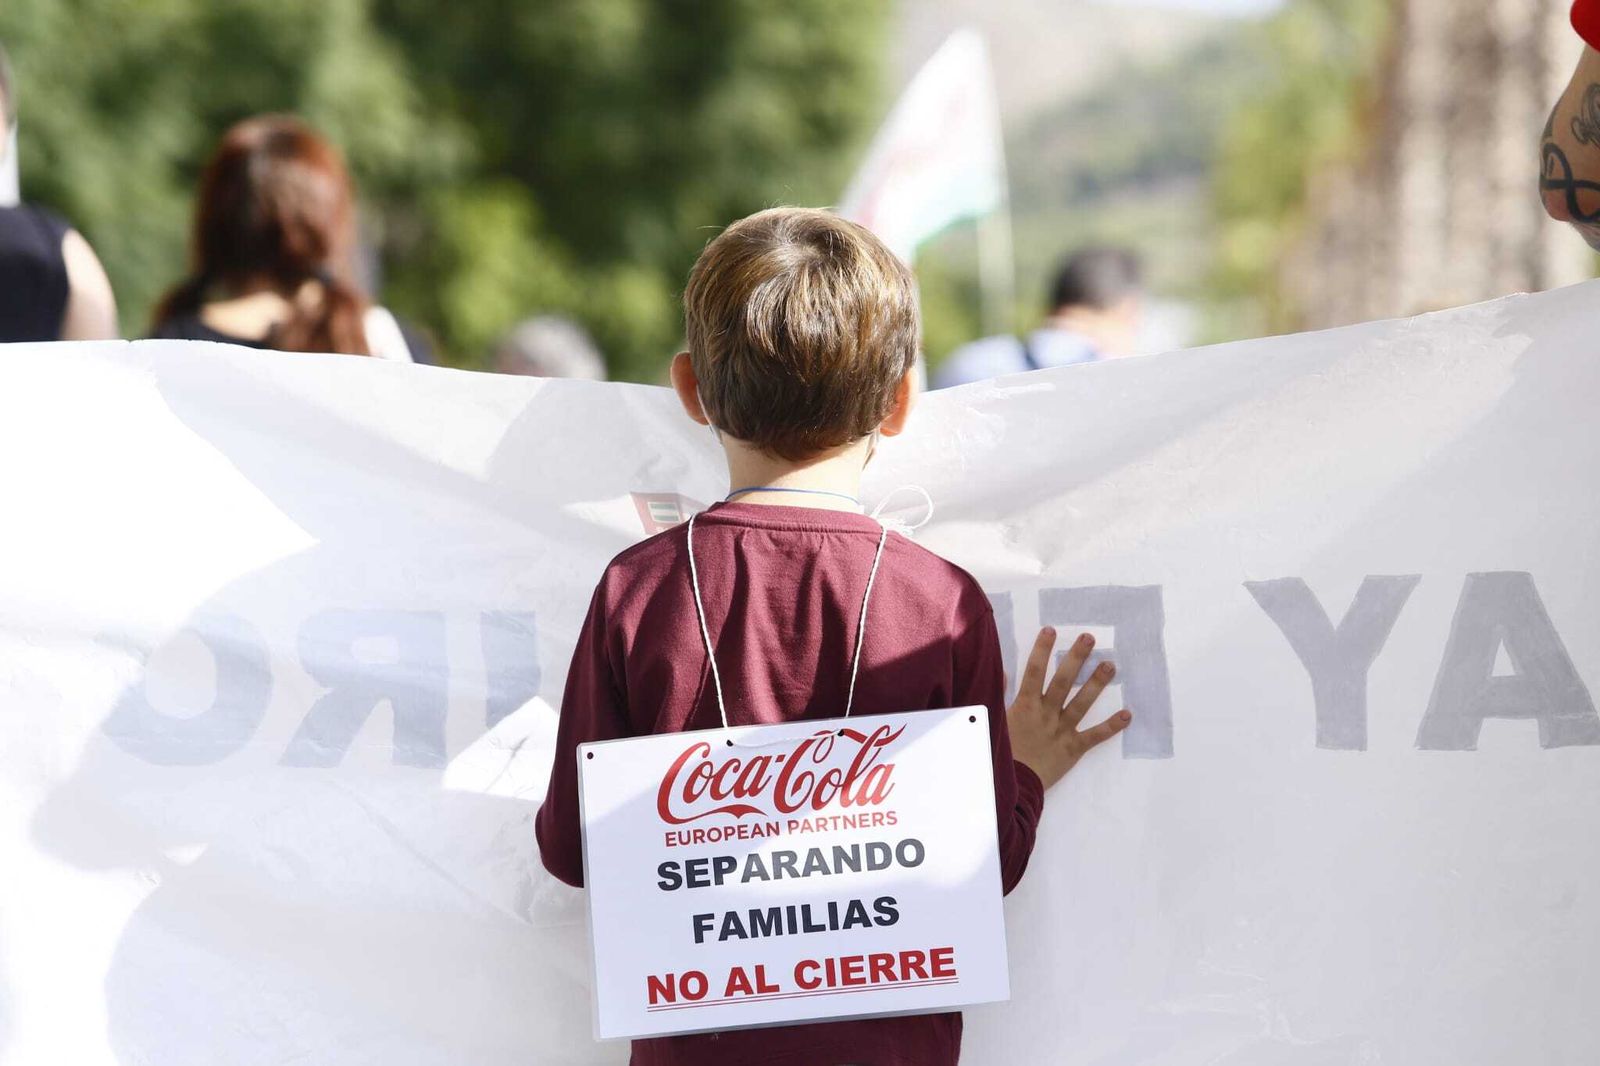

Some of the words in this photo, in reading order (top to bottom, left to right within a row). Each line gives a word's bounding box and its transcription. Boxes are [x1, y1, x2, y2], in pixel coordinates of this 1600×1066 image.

[657, 723, 907, 825] Coca-Cola
[665, 822, 781, 848] EUROPEAN
[786, 810, 898, 836] PARTNERS
[657, 838, 926, 892] SEPARANDO
[693, 896, 900, 944] FAMILIAS
[647, 970, 709, 1006] NO
[724, 964, 781, 998] AL
[794, 946, 957, 990] CIERRE
